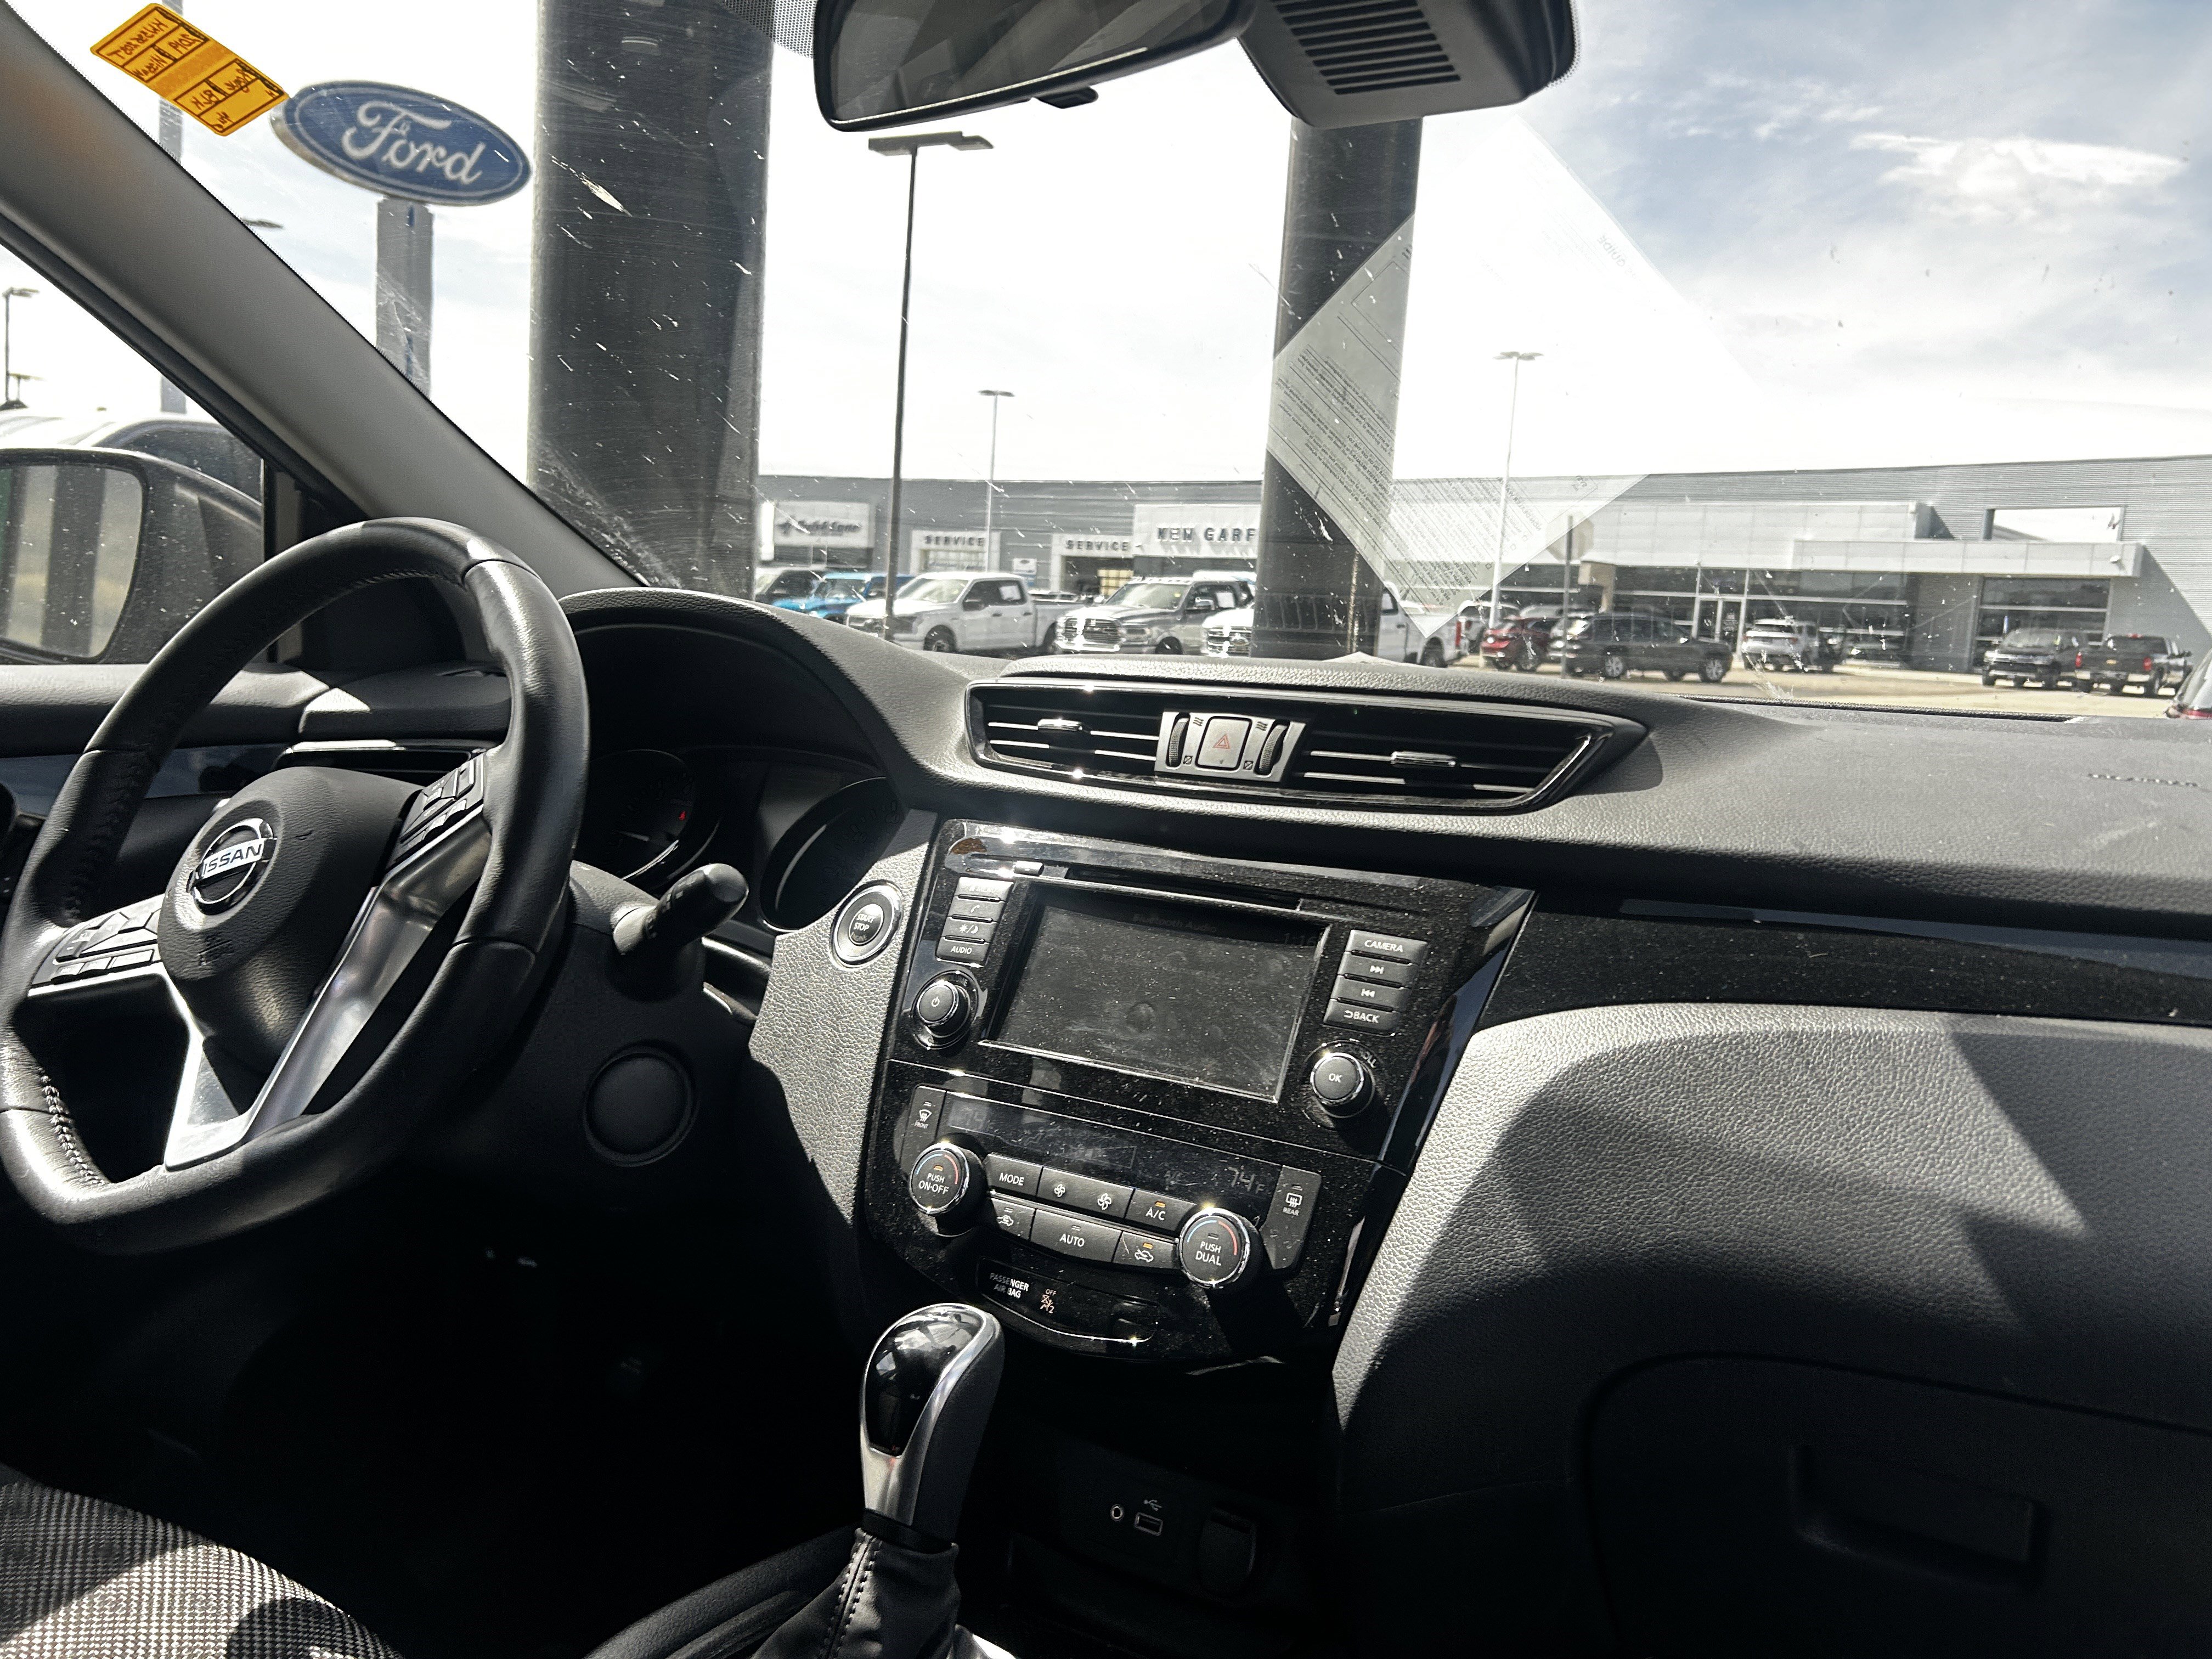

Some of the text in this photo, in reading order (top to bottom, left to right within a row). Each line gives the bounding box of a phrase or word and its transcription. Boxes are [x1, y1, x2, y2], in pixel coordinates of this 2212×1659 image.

[342, 101, 486, 184] Ford
[924, 535, 985, 546] SERVICE
[1204, 527, 1257, 542] GARF
[1066, 540, 1128, 551] SERVICE
[202, 844, 262, 876] ISSAN
[856, 913, 876, 923] START
[854, 922, 870, 931] STOP
[950, 945, 972, 954] AUDIO
[1364, 939, 1403, 953] CAMERA
[1353, 1011, 1379, 1024] BACK
[1328, 1073, 1343, 1083] OK
[915, 1119, 929, 1129] FRONT
[927, 1172, 945, 1183] PUSH
[998, 1172, 1024, 1186] MODE
[1146, 1207, 1166, 1221] A/C
[1283, 1207, 1299, 1216] REAR
[1059, 1233, 1085, 1248] AUTO
[1200, 1241, 1221, 1254] PUSH
[1195, 1251, 1222, 1266] DUAL
[989, 1272, 1029, 1291] PASSENGER
[994, 1284, 1022, 1299] AIR BAG
